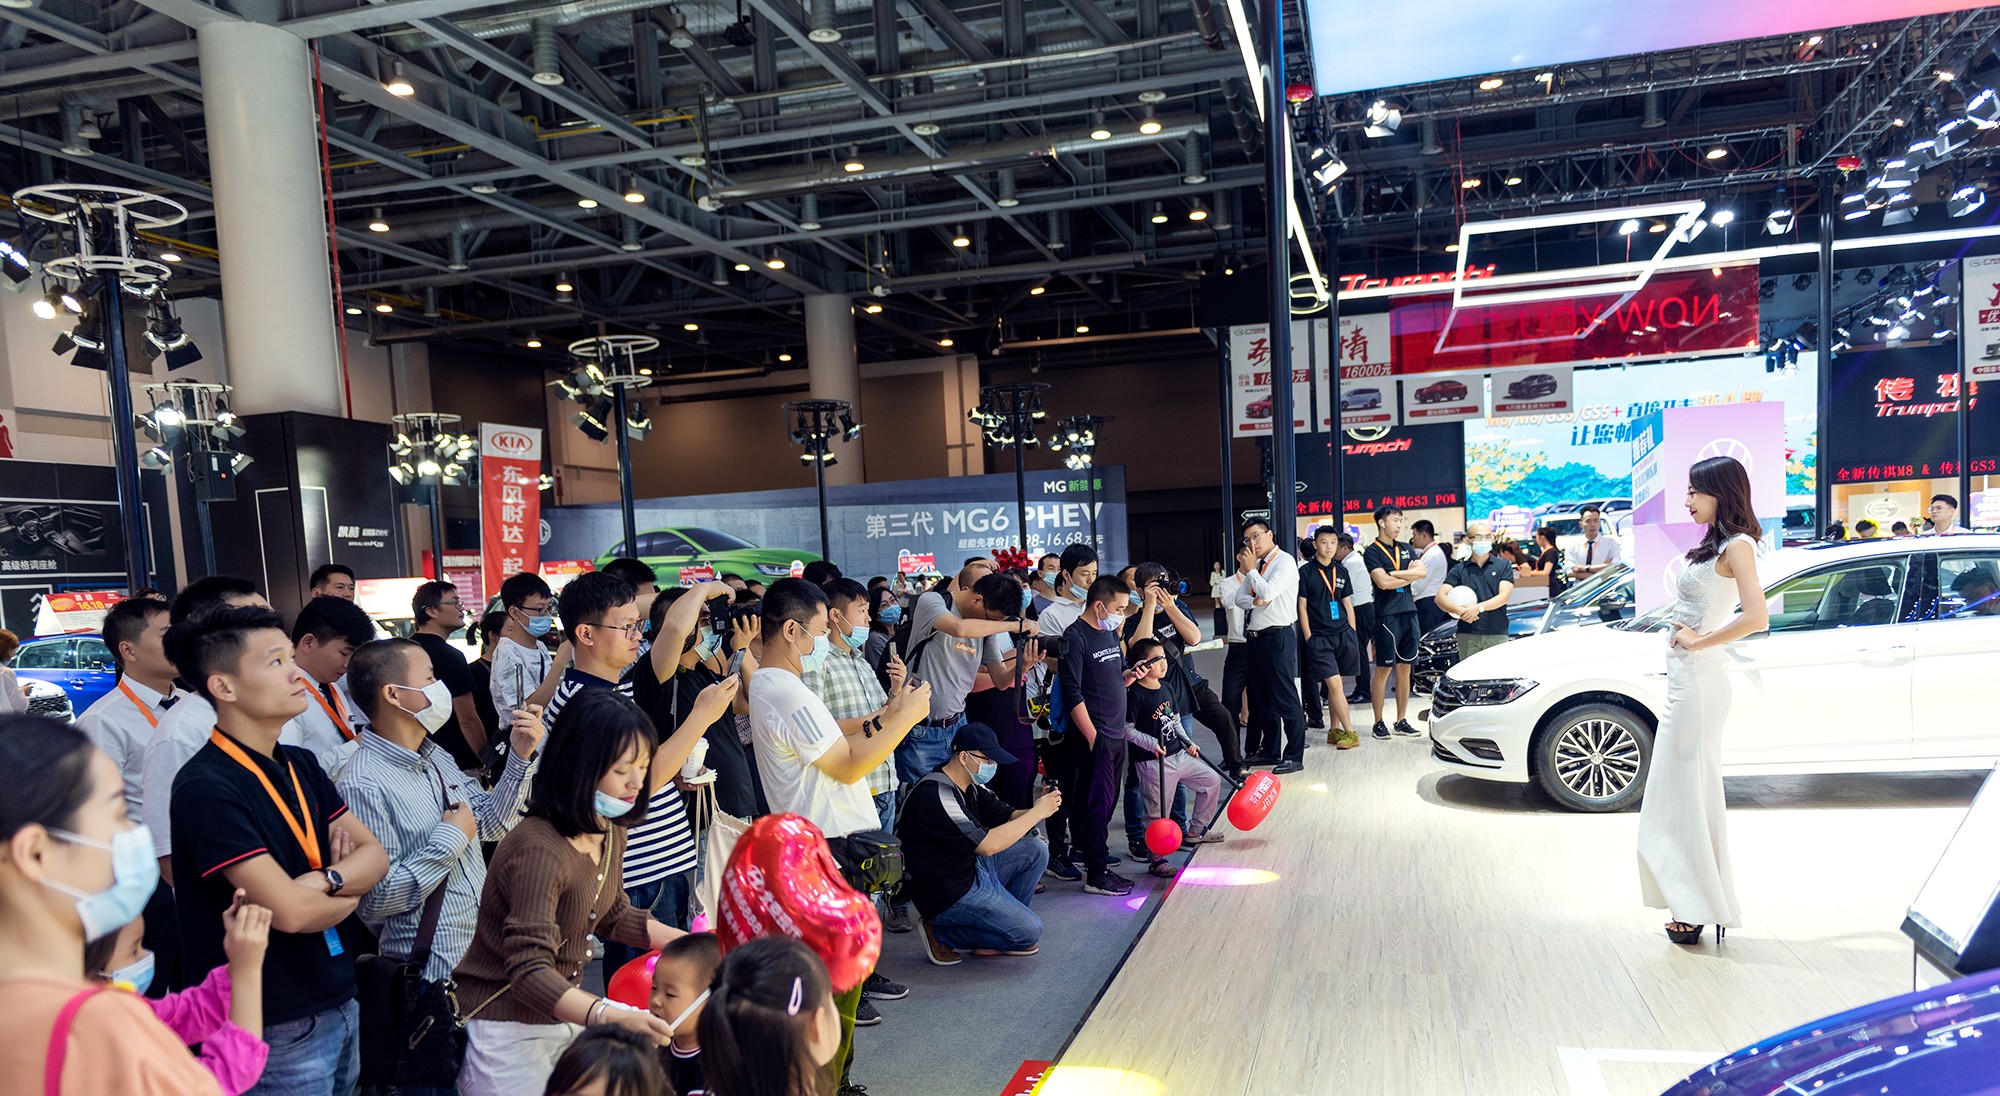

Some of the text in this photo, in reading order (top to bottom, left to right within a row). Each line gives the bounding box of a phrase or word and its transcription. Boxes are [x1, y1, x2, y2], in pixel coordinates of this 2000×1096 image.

[499, 436, 526, 448] KIA
[1327, 438, 1412, 456] umpchi
[1921, 464, 1930, 475] &
[1043, 480, 1067, 493] MG
[1296, 499, 1360, 514] 全新传M8
[1366, 498, 1374, 509] &
[502, 464, 525, 579] 东风悦达·起
[865, 502, 1103, 540] 第三代 MG6 PHEV
